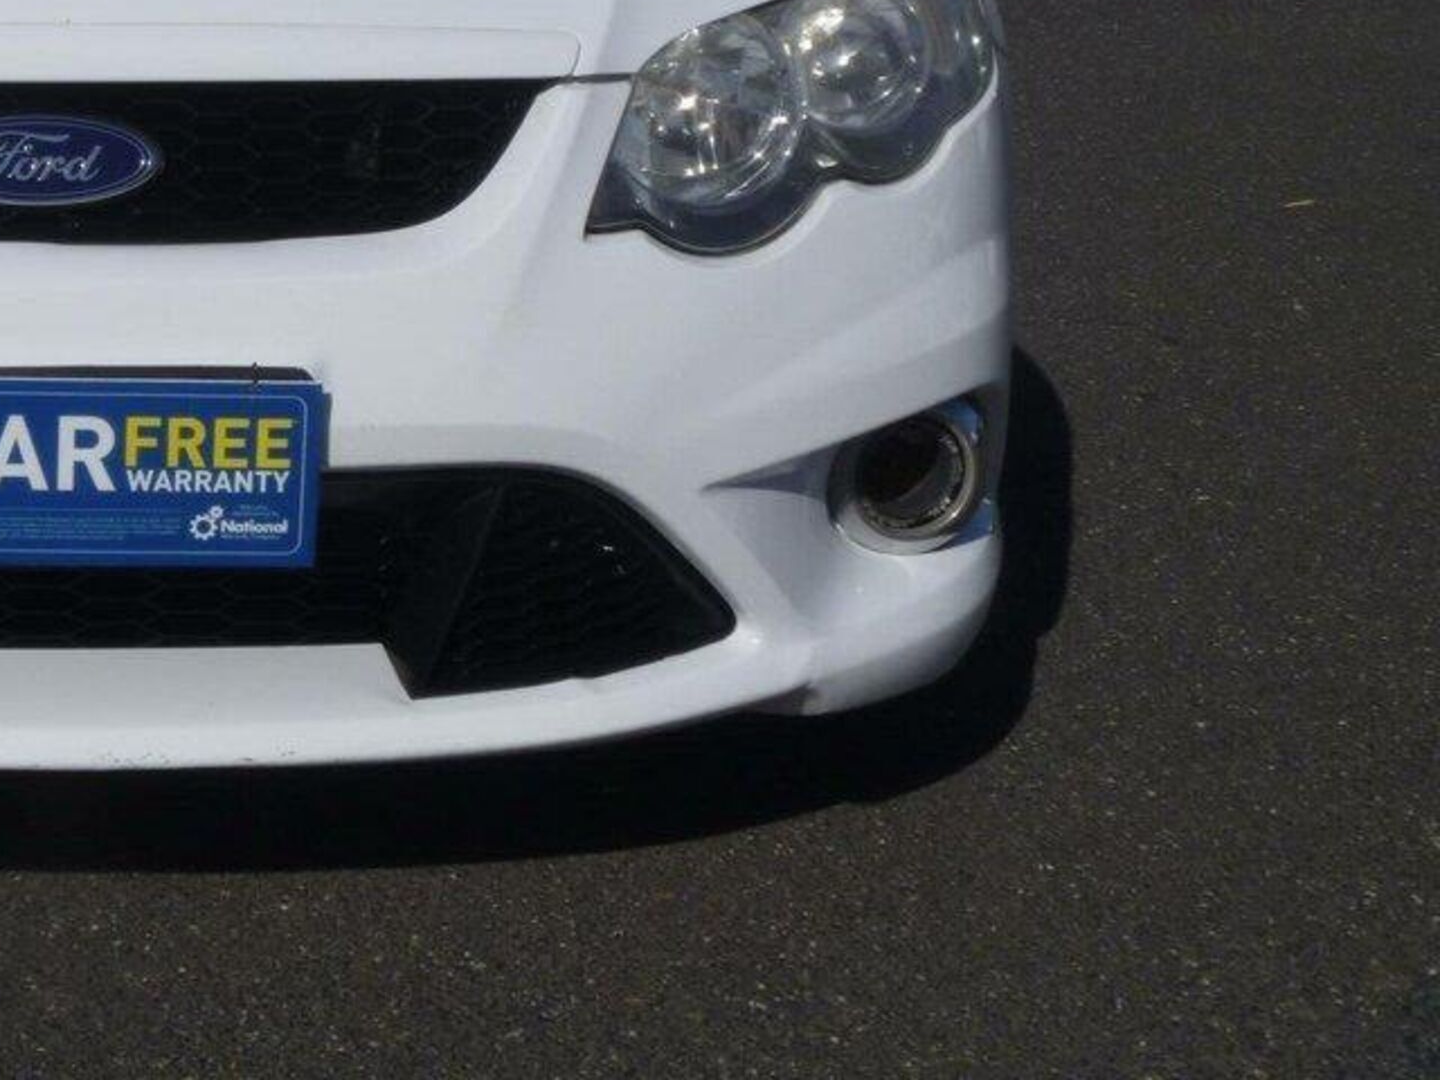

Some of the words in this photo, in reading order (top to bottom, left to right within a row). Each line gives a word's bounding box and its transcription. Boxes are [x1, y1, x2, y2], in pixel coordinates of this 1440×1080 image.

[124, 415, 293, 469] FREE
[126, 469, 290, 493] WARRANTY
[220, 518, 289, 534] National
